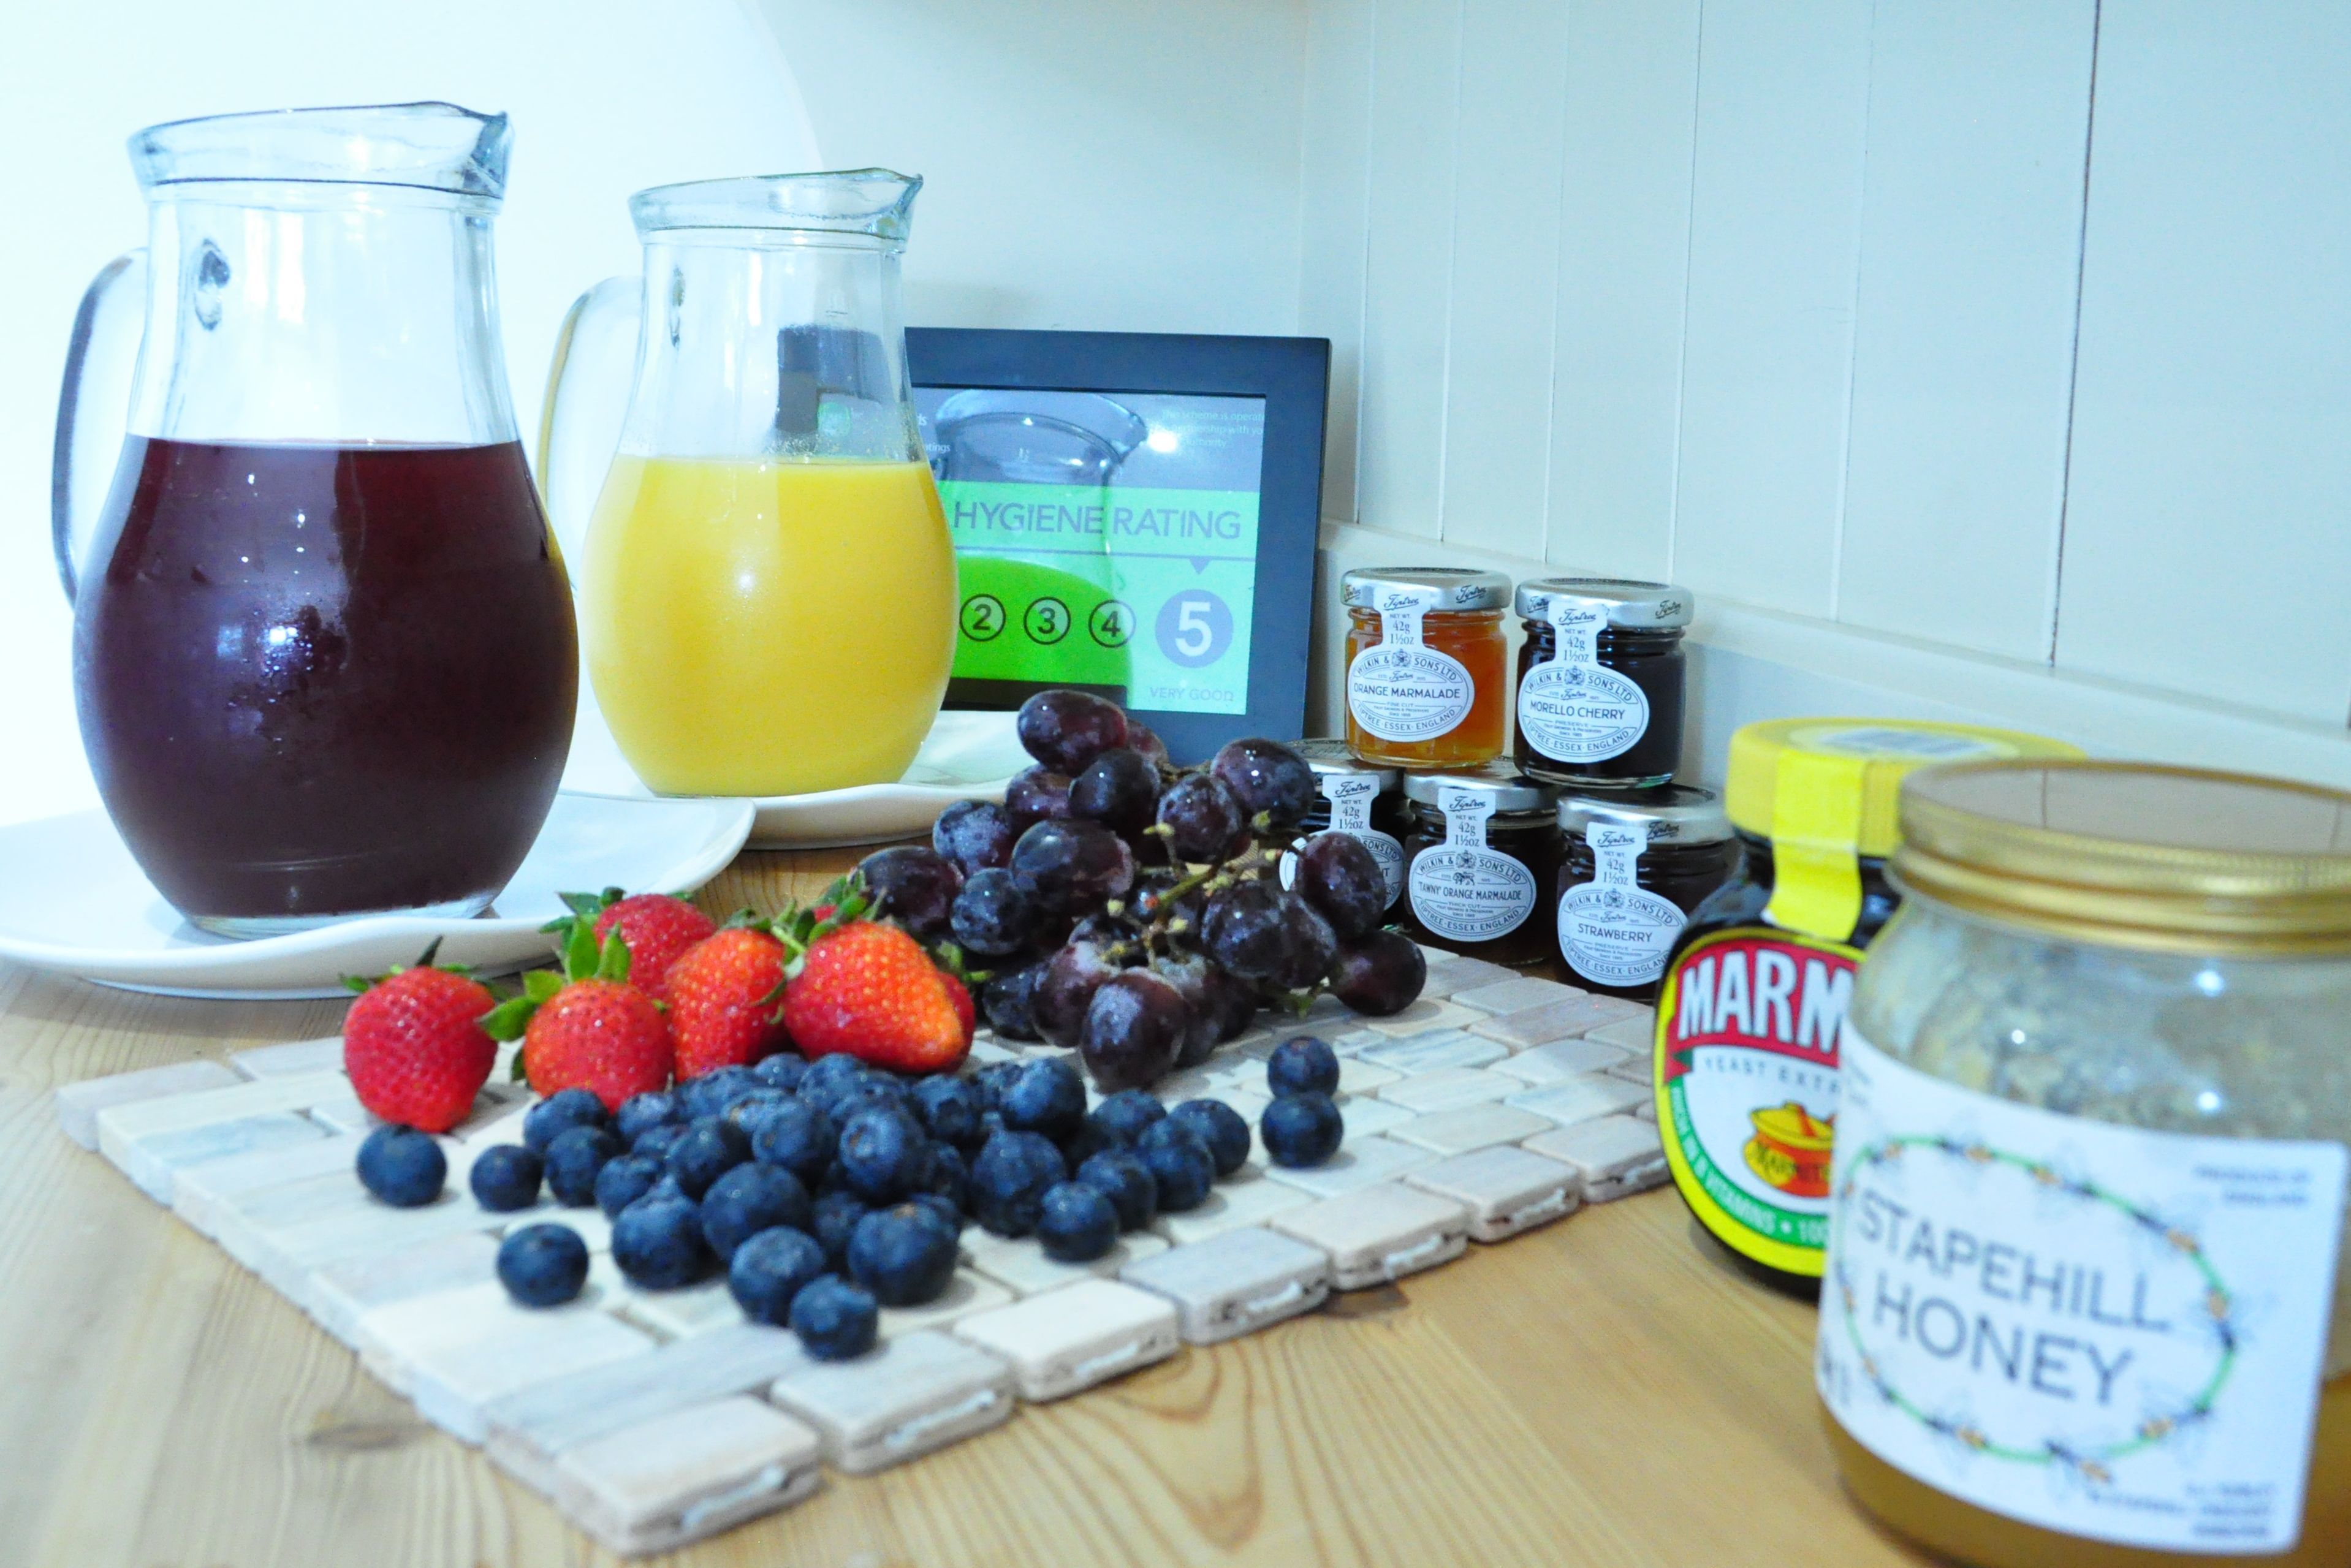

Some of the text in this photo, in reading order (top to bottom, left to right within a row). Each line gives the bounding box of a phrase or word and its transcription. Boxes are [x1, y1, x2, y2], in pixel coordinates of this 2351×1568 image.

[954, 501, 1241, 540] HYGIENE RATING
[973, 604, 992, 631] 2
[1037, 607, 1055, 634] 3
[1101, 611, 1121, 638] 4
[1392, 620, 1410, 634] 42g
[1175, 601, 1213, 658] 5
[1567, 636, 1586, 651] 42g
[1358, 656, 1457, 681] WILKIN & SONS LTD
[1149, 687, 1234, 702] VERY GOOD
[1353, 683, 1461, 699] ORANGE MARMALADE
[1556, 672, 1562, 681] &
[1588, 675, 1614, 692] SONS
[1615, 684, 1633, 702] LTD
[1384, 722, 1412, 731] ESSEX
[1416, 709, 1456, 730] ENGLAND
[1530, 700, 1626, 720] MORELLO CHERRY
[1554, 741, 1582, 751] ESSEX
[1587, 730, 1630, 751] ENGLAND
[1342, 806, 1360, 819] 42g
[1458, 822, 1476, 837] 42g
[1363, 840, 1384, 852] SONS
[1419, 857, 1443, 873] WILKIN
[1479, 859, 1505, 873] SONS
[1505, 866, 1521, 882] LTD
[1606, 857, 1625, 874] 42g
[1443, 887, 1473, 900] ORANGE
[1476, 890, 1522, 901] MARMALADE
[1447, 922, 1476, 931] ESSEX
[1479, 909, 1520, 931] ENGLAND
[1567, 894, 1673, 925] WILKIN & SONS LTD
[1578, 923, 1653, 943] STRAWBERRY
[1593, 964, 1623, 975] ESSEX
[1627, 954, 1668, 975] ENGLAN
[1859, 1187, 2170, 1336] STAPEHILL
[1872, 1272, 2134, 1408] HONEY
